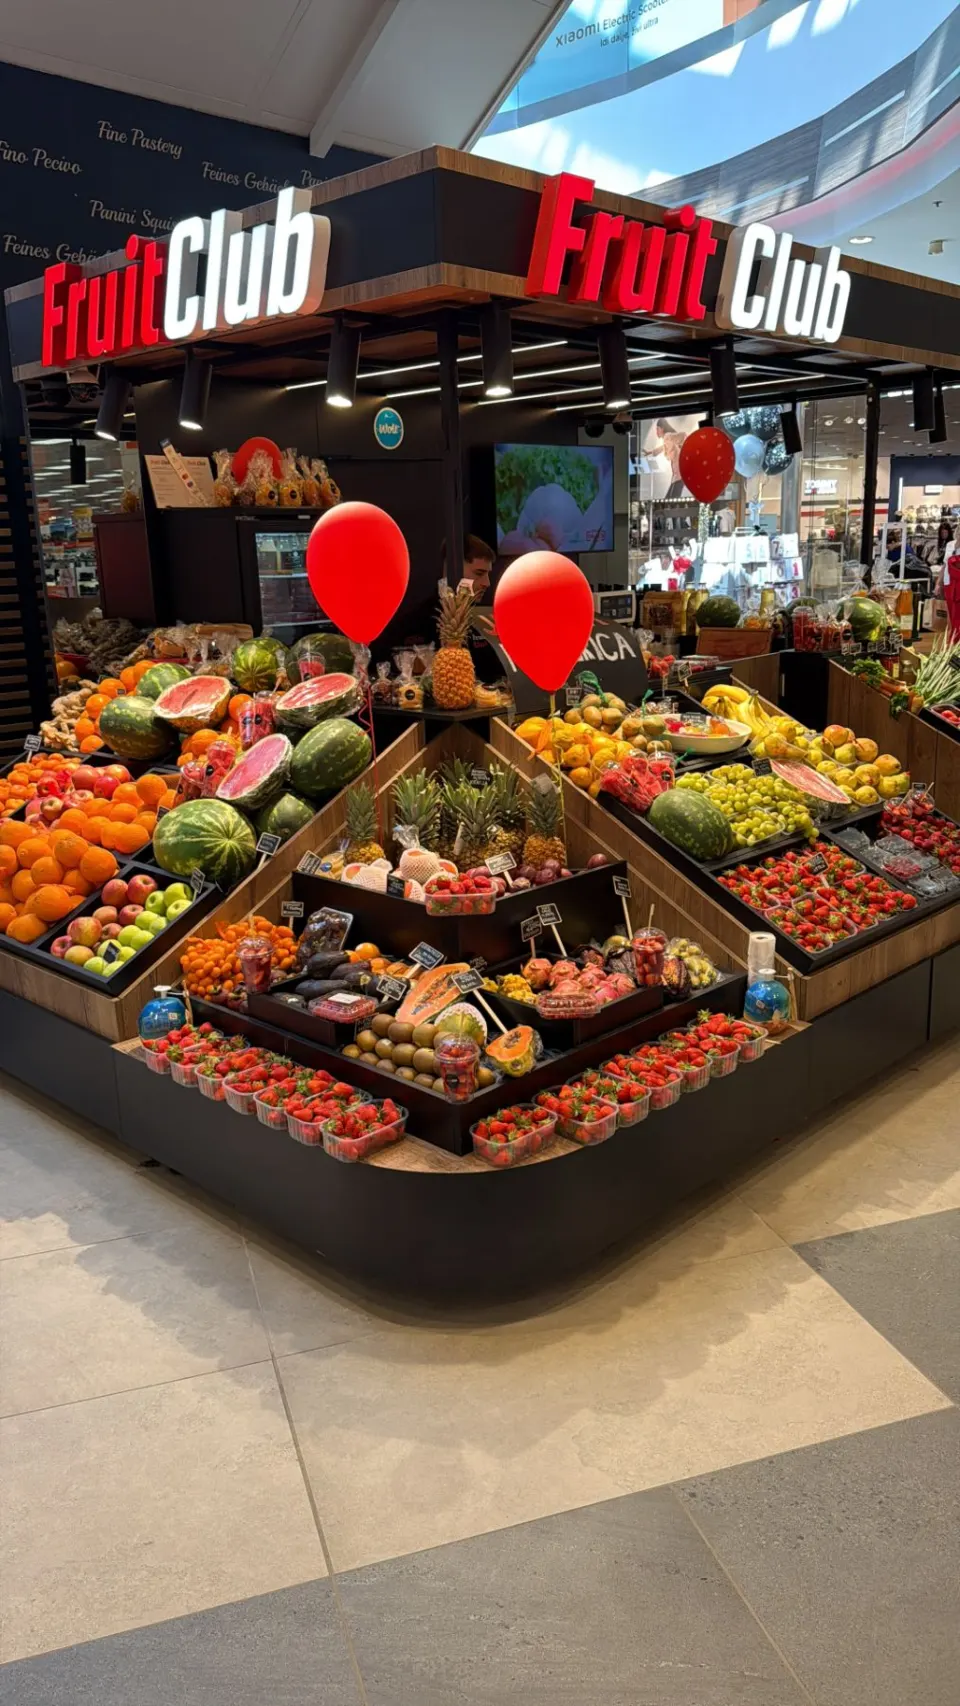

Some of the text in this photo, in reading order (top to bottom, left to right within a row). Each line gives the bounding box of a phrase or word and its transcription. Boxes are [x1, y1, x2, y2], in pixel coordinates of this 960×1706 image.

[603, 9, 636, 31] Electric
[97, 120, 183, 160] Fine Pastery
[32, 148, 83, 175] Pecivo
[202, 161, 240, 186] Feines
[89, 199, 138, 225] Panini
[3, 234, 50, 260] Feines
[526, 172, 852, 344] Fruit Club
